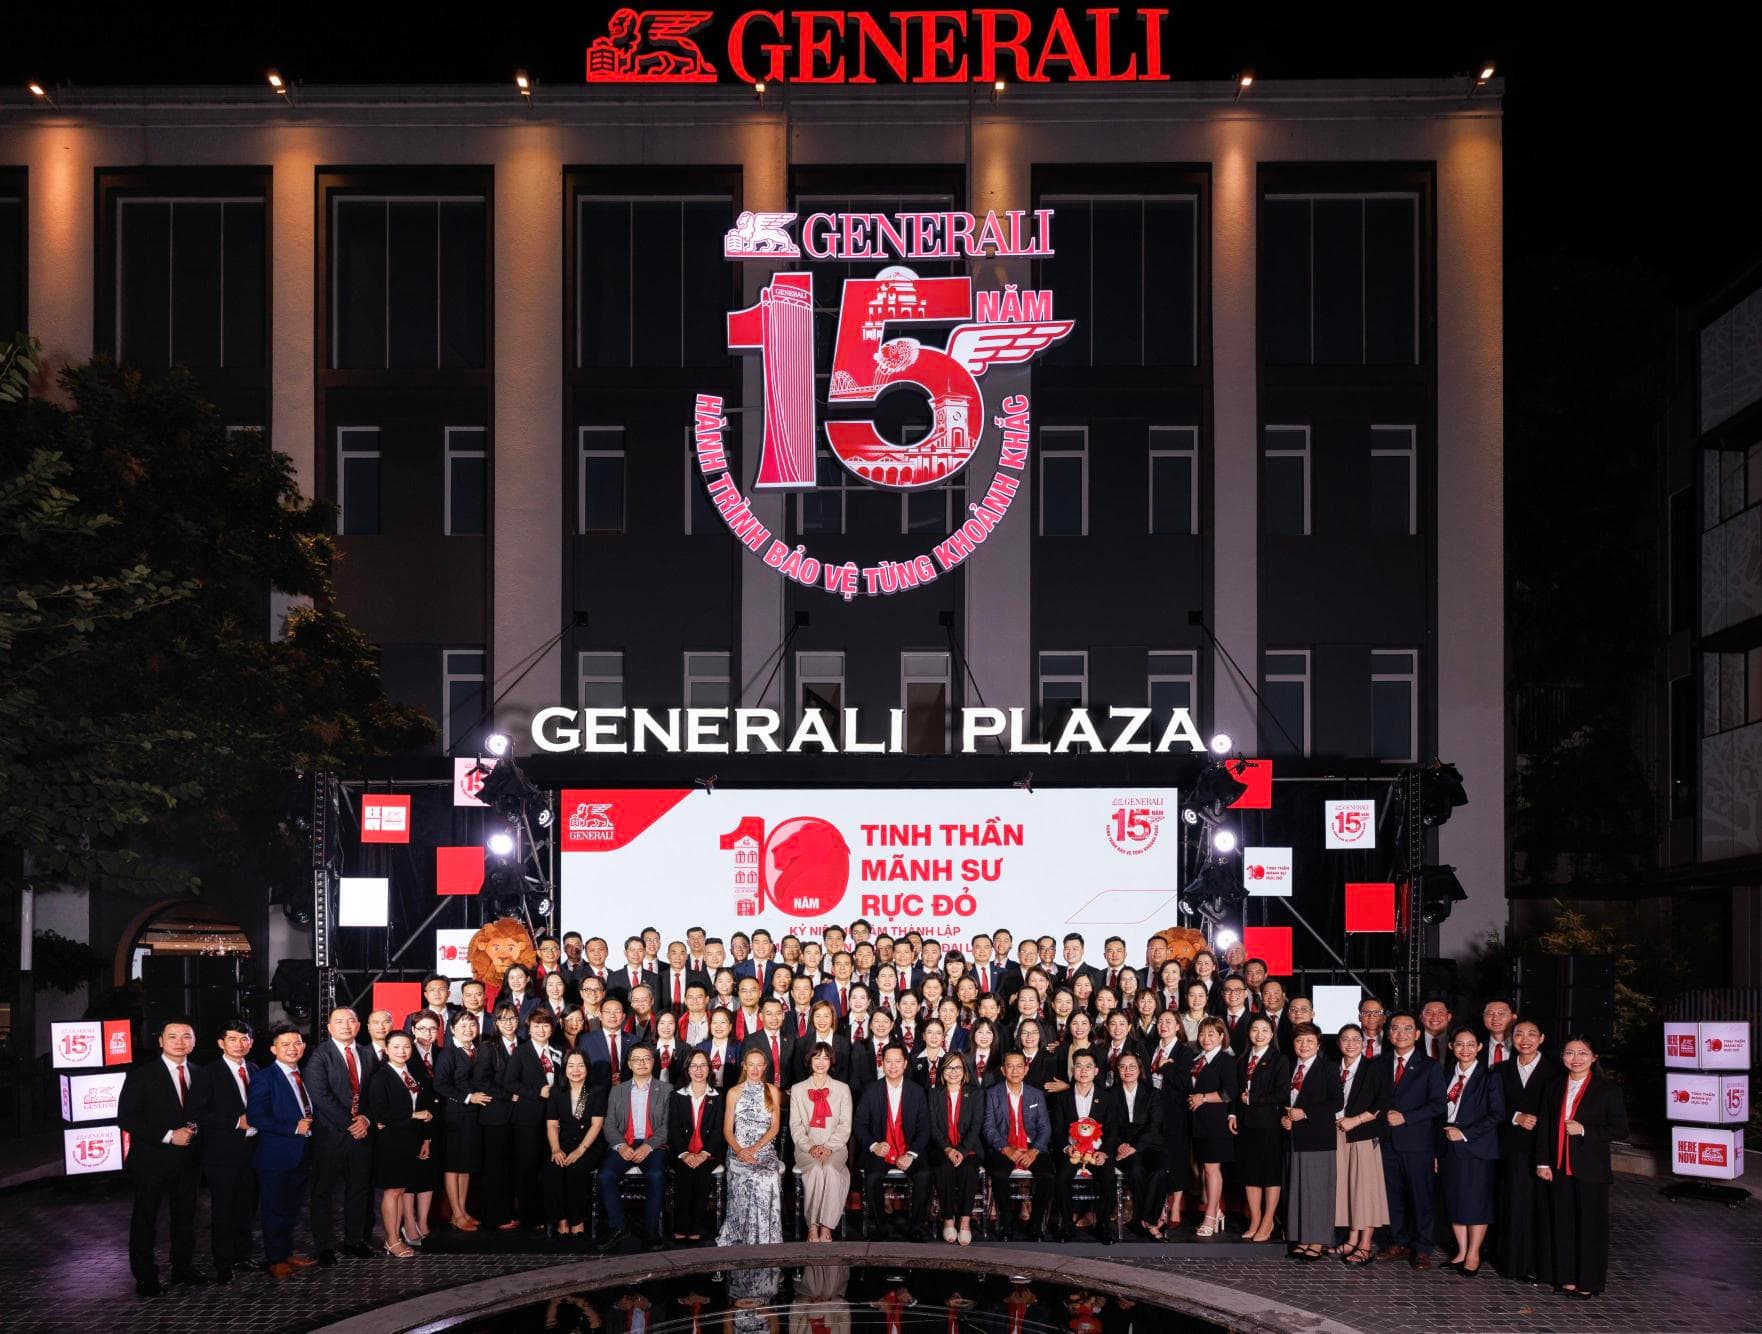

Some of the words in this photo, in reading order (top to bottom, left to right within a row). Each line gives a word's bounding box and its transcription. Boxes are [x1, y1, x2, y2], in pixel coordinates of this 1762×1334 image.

[727, 8, 1170, 83] GENERALI
[803, 209, 1055, 258] GENERALI
[726, 266, 985, 489] 15
[976, 284, 1053, 322] NĂM
[695, 393, 728, 473] HÀNH
[995, 394, 1029, 470] KHẮC
[708, 472, 771, 551] TRÌNH
[933, 472, 1020, 571] KHOẢNH
[763, 541, 821, 584] BẢO
[862, 553, 937, 595] TỪNG
[824, 562, 859, 600] VỆ
[531, 707, 903, 753] GENERALI
[960, 707, 1208, 753] PLAZA
[1125, 798, 1163, 806] GENERALI
[569, 831, 614, 840] GENERALI
[860, 824, 931, 846] TINH
[940, 816, 1024, 846] THẦN
[1112, 808, 1151, 841] 15
[1335, 811, 1361, 833] 15
[720, 816, 851, 917] 10
[861, 854, 953, 881] MÃNH
[961, 857, 1003, 881] SƯ
[794, 896, 819, 909] NĂM
[861, 893, 924, 921] RỰC
[931, 887, 977, 917] ĐỎ
[789, 923, 806, 936] KỶ
[937, 924, 961, 938] LẬP
[61, 1035, 88, 1054] 15
[1727, 1089, 1740, 1109] 15
[76, 1139, 105, 1160] 15
[1678, 1141, 1696, 1152] HERE
[1678, 1152, 1696, 1164] NOW
